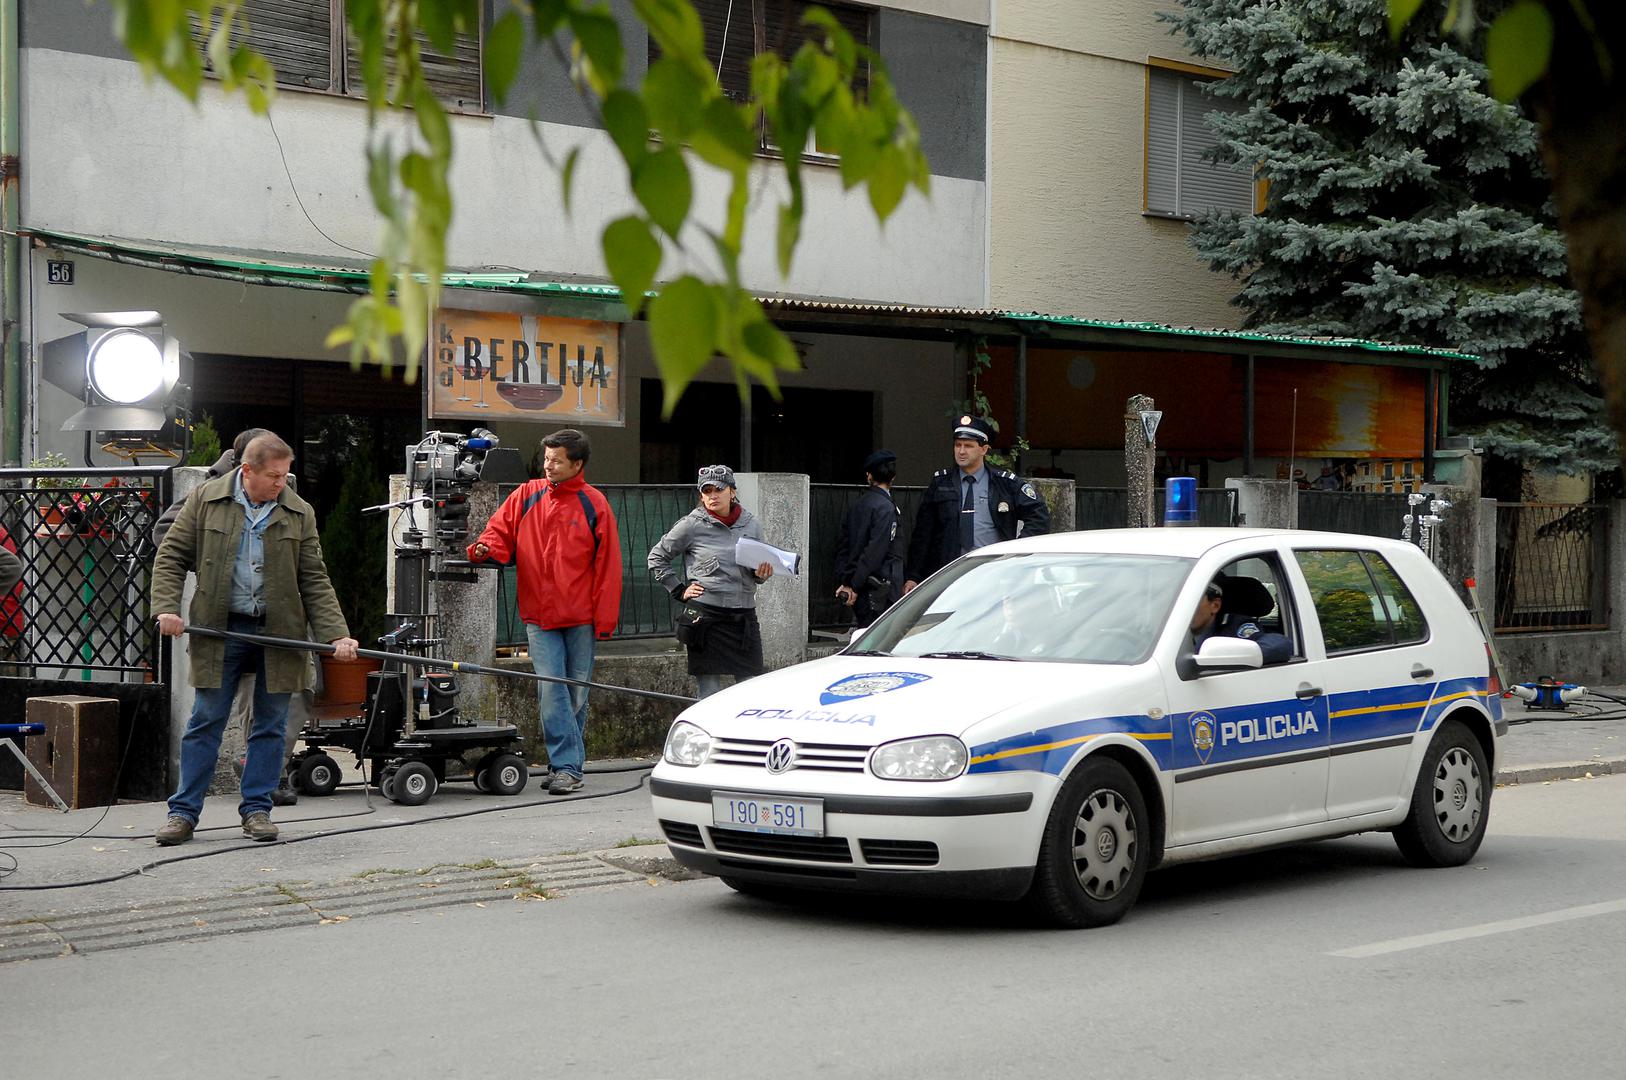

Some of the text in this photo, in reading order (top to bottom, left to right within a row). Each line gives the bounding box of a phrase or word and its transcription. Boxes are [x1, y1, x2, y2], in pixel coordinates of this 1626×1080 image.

[52, 263, 70, 281] 56
[438, 322, 454, 388] kod
[463, 336, 608, 389] BERTIJA
[735, 709, 877, 727] POLICIJA
[1220, 710, 1319, 746] POLICIJA
[730, 801, 804, 828] 190 591
